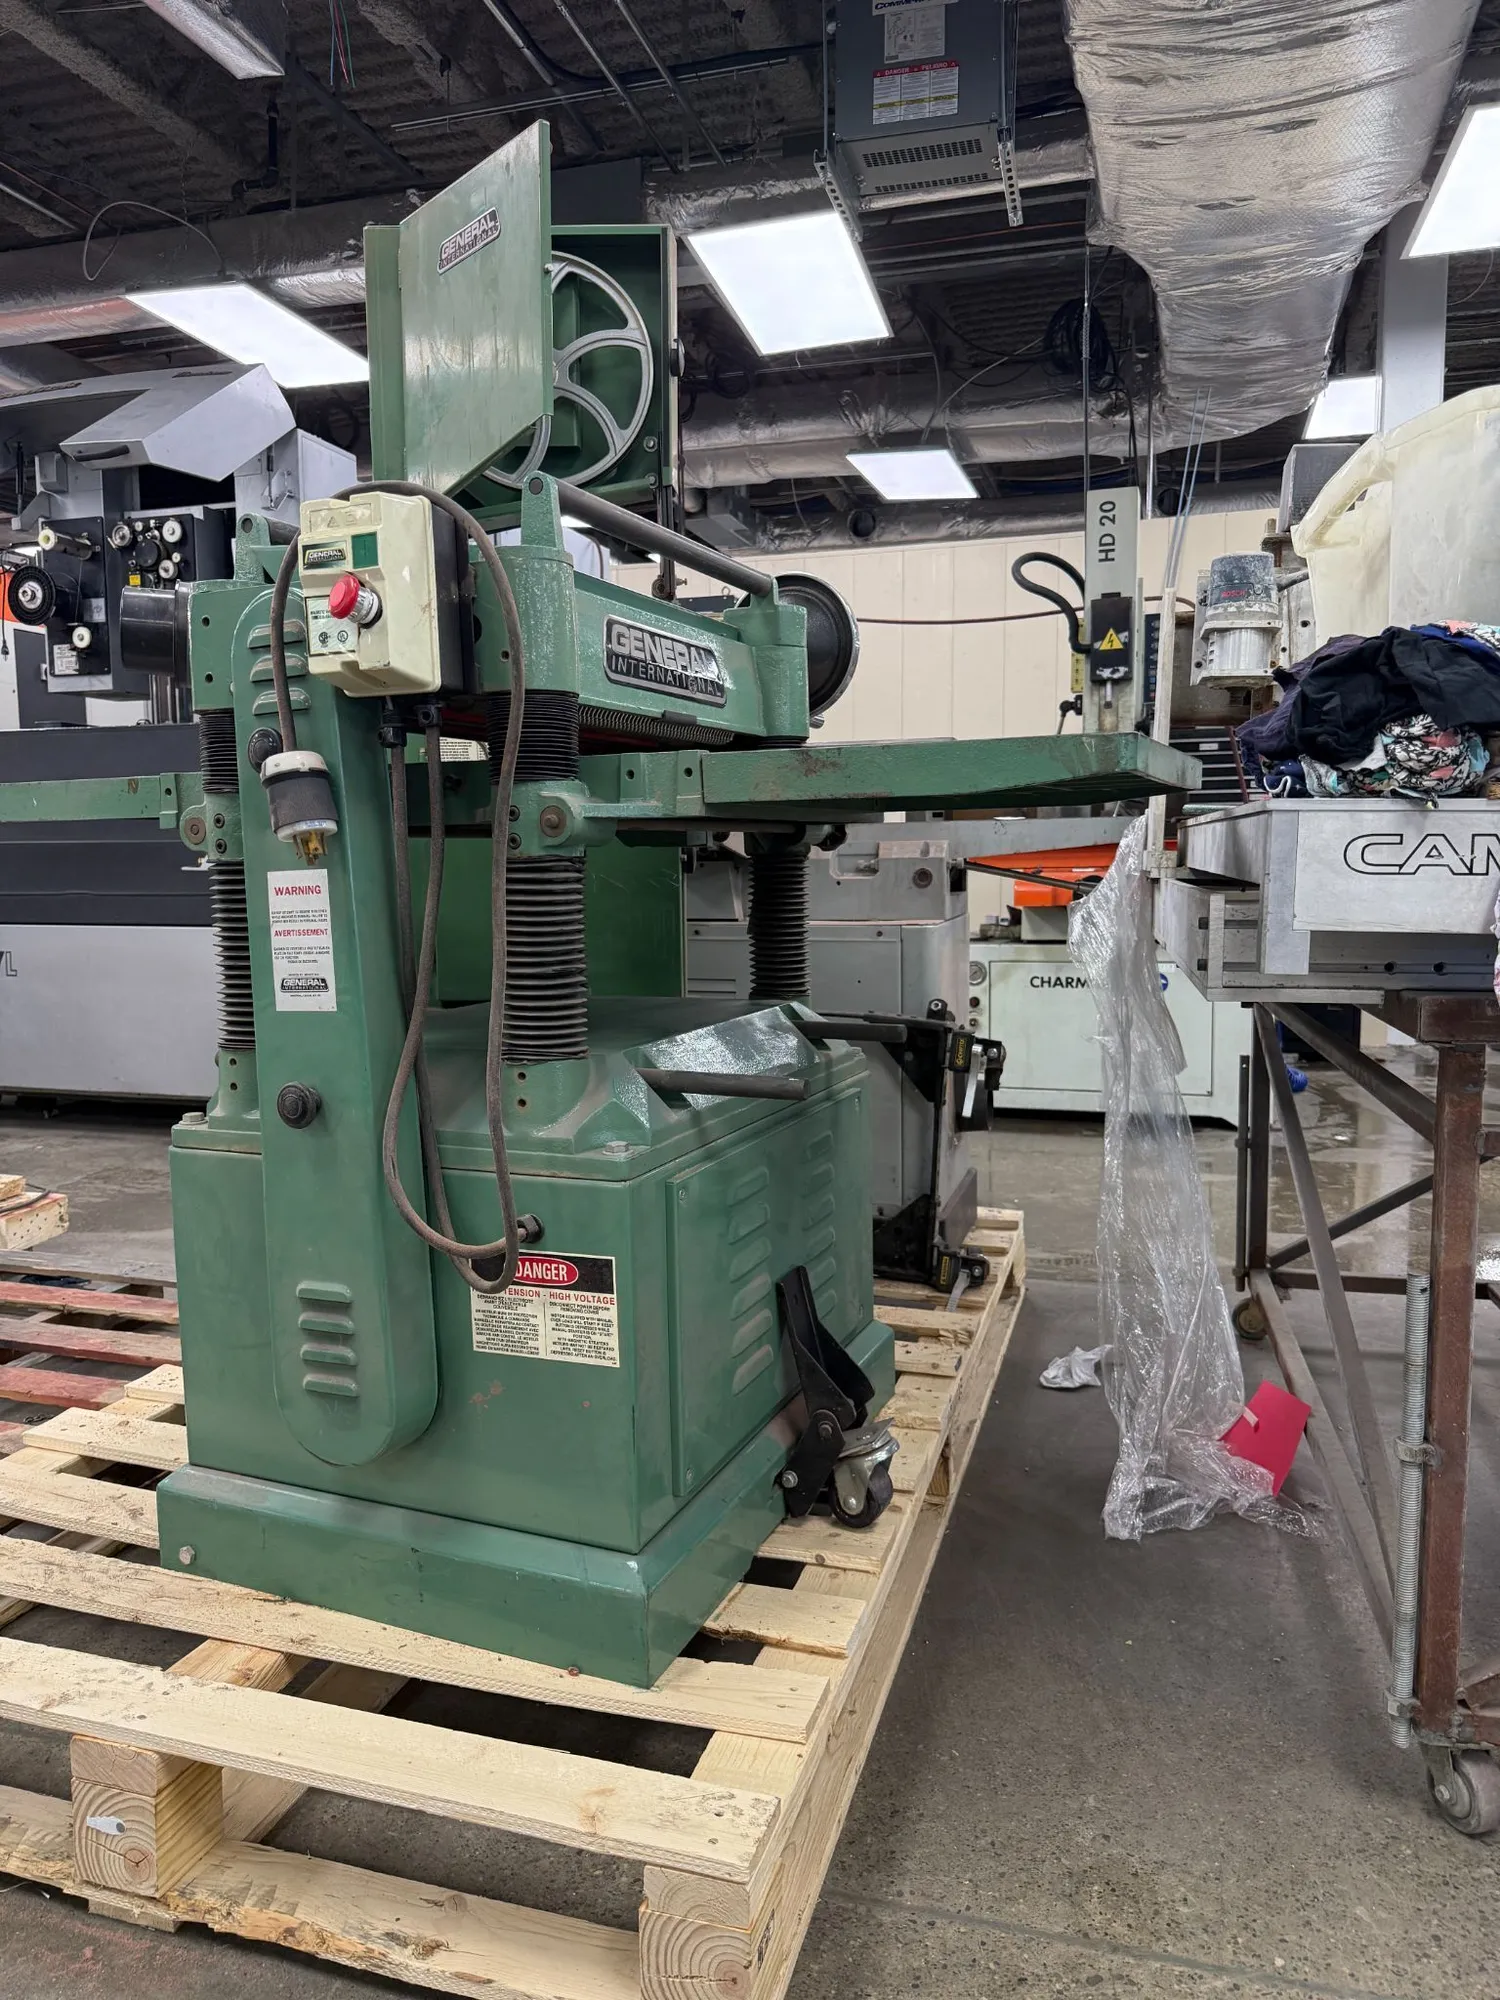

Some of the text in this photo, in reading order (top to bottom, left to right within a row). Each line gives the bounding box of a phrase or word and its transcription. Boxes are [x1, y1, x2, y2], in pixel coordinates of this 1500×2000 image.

[439, 227, 497, 269] INTERNATIONAL
[441, 214, 494, 260] GENERAL
[1098, 500, 1116, 563] HD 20
[308, 549, 342, 559] GENERAL
[611, 624, 712, 678] GENERAL
[611, 655, 721, 696] INTERNATIONAL
[274, 885, 321, 896] WARNING
[274, 928, 328, 937] AVERTISSEMENT
[514, 1260, 568, 1282] DANGER
[549, 1291, 571, 1301] HIGH
[574, 1293, 616, 1306] VOLTAGE
